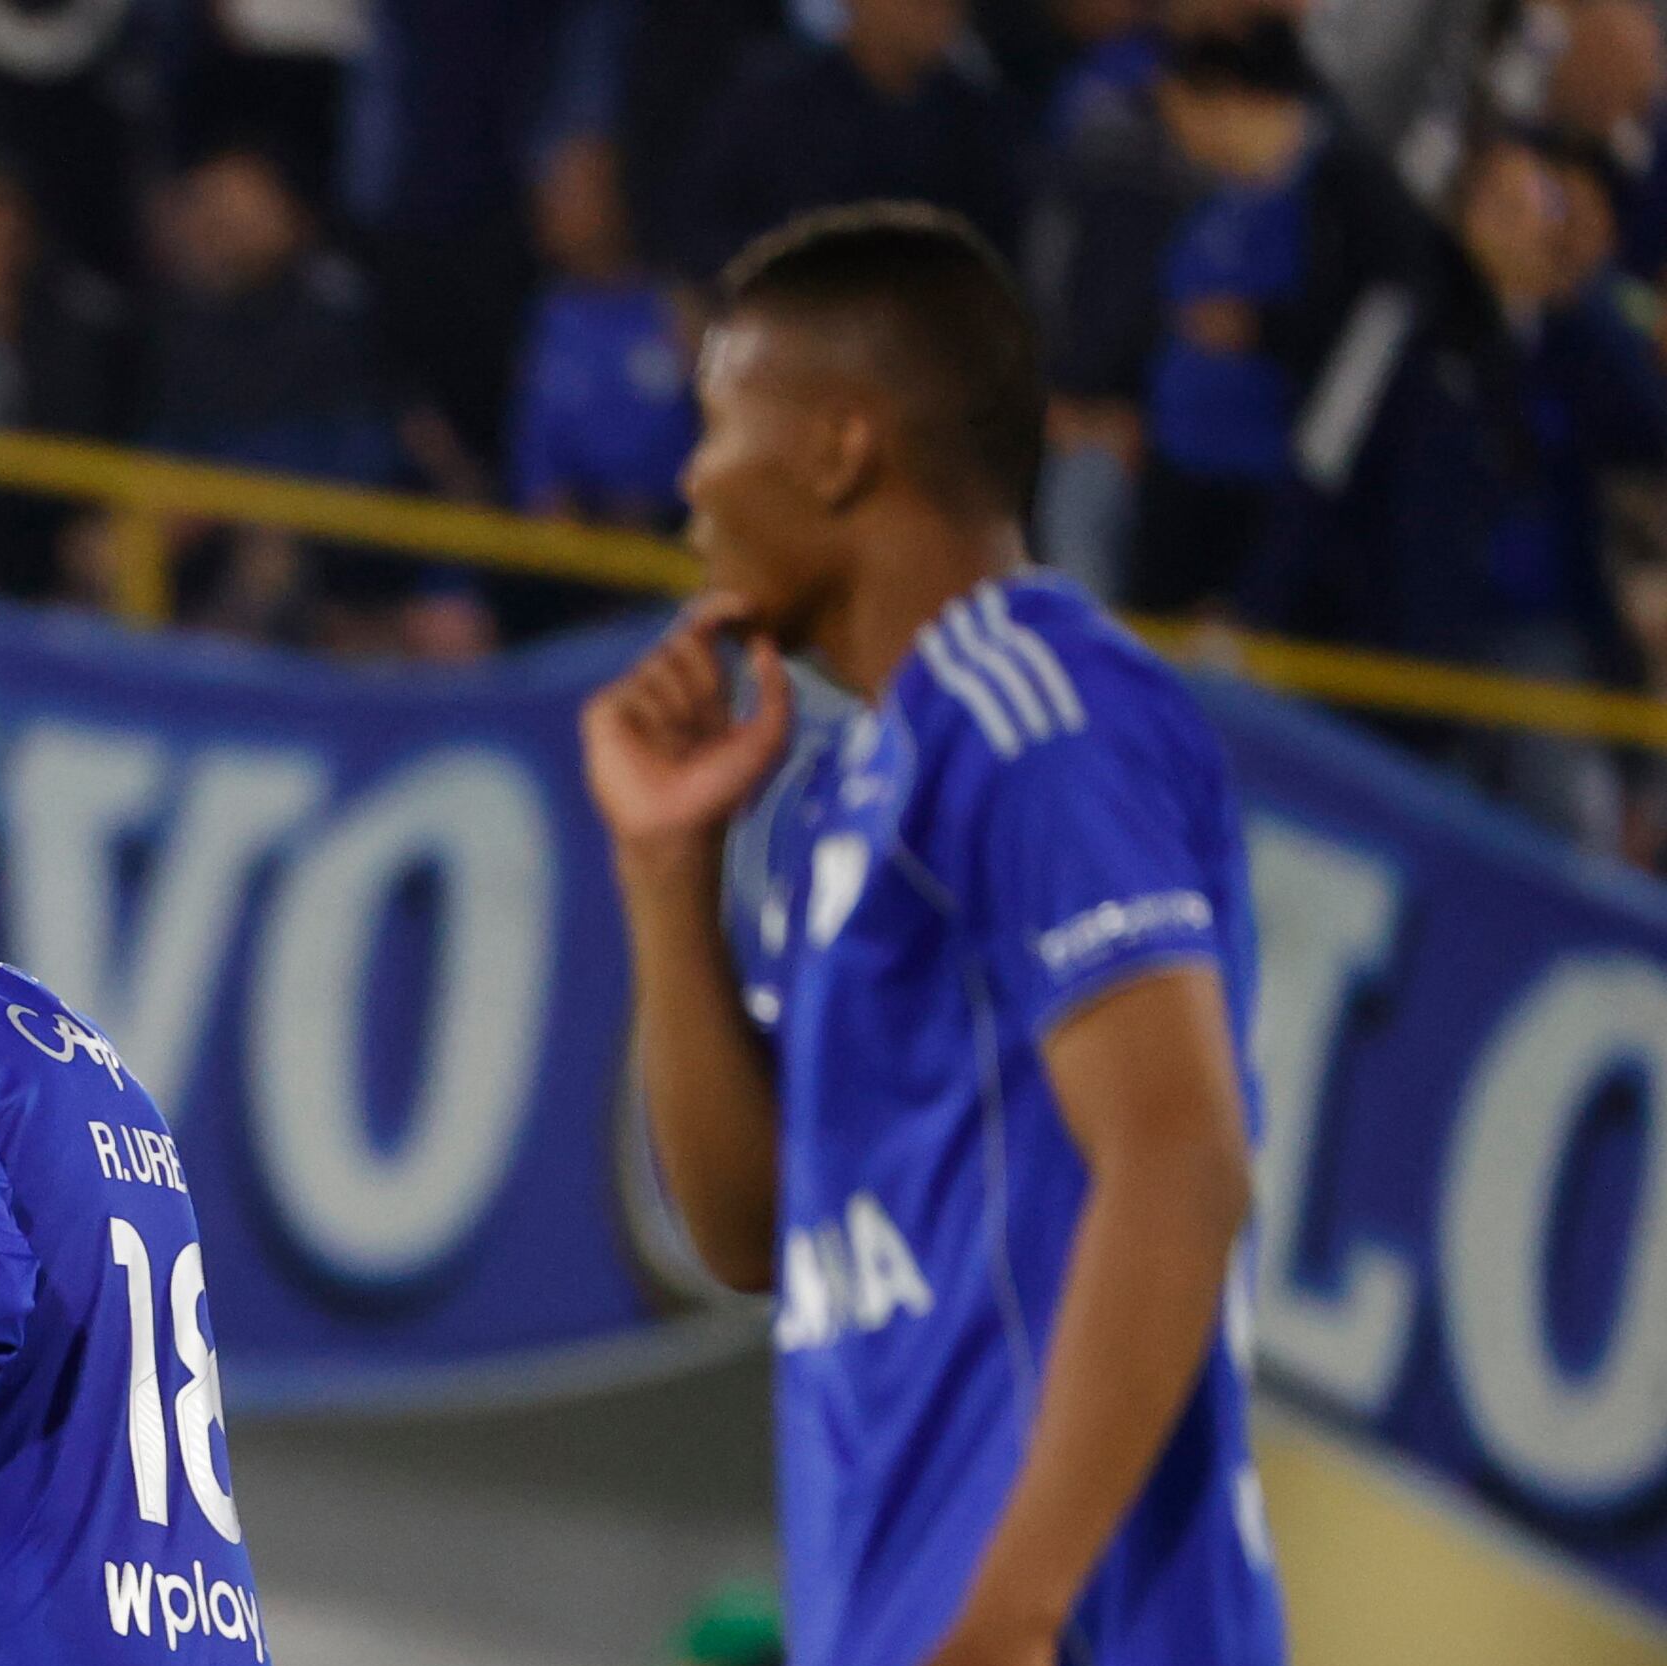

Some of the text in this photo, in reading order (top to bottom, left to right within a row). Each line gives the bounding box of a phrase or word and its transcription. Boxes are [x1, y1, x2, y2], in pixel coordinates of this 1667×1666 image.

[87, 1121, 188, 1194] R.URE
[1242, 802, 1667, 1505] LO
[109, 1216, 242, 1545] 18
